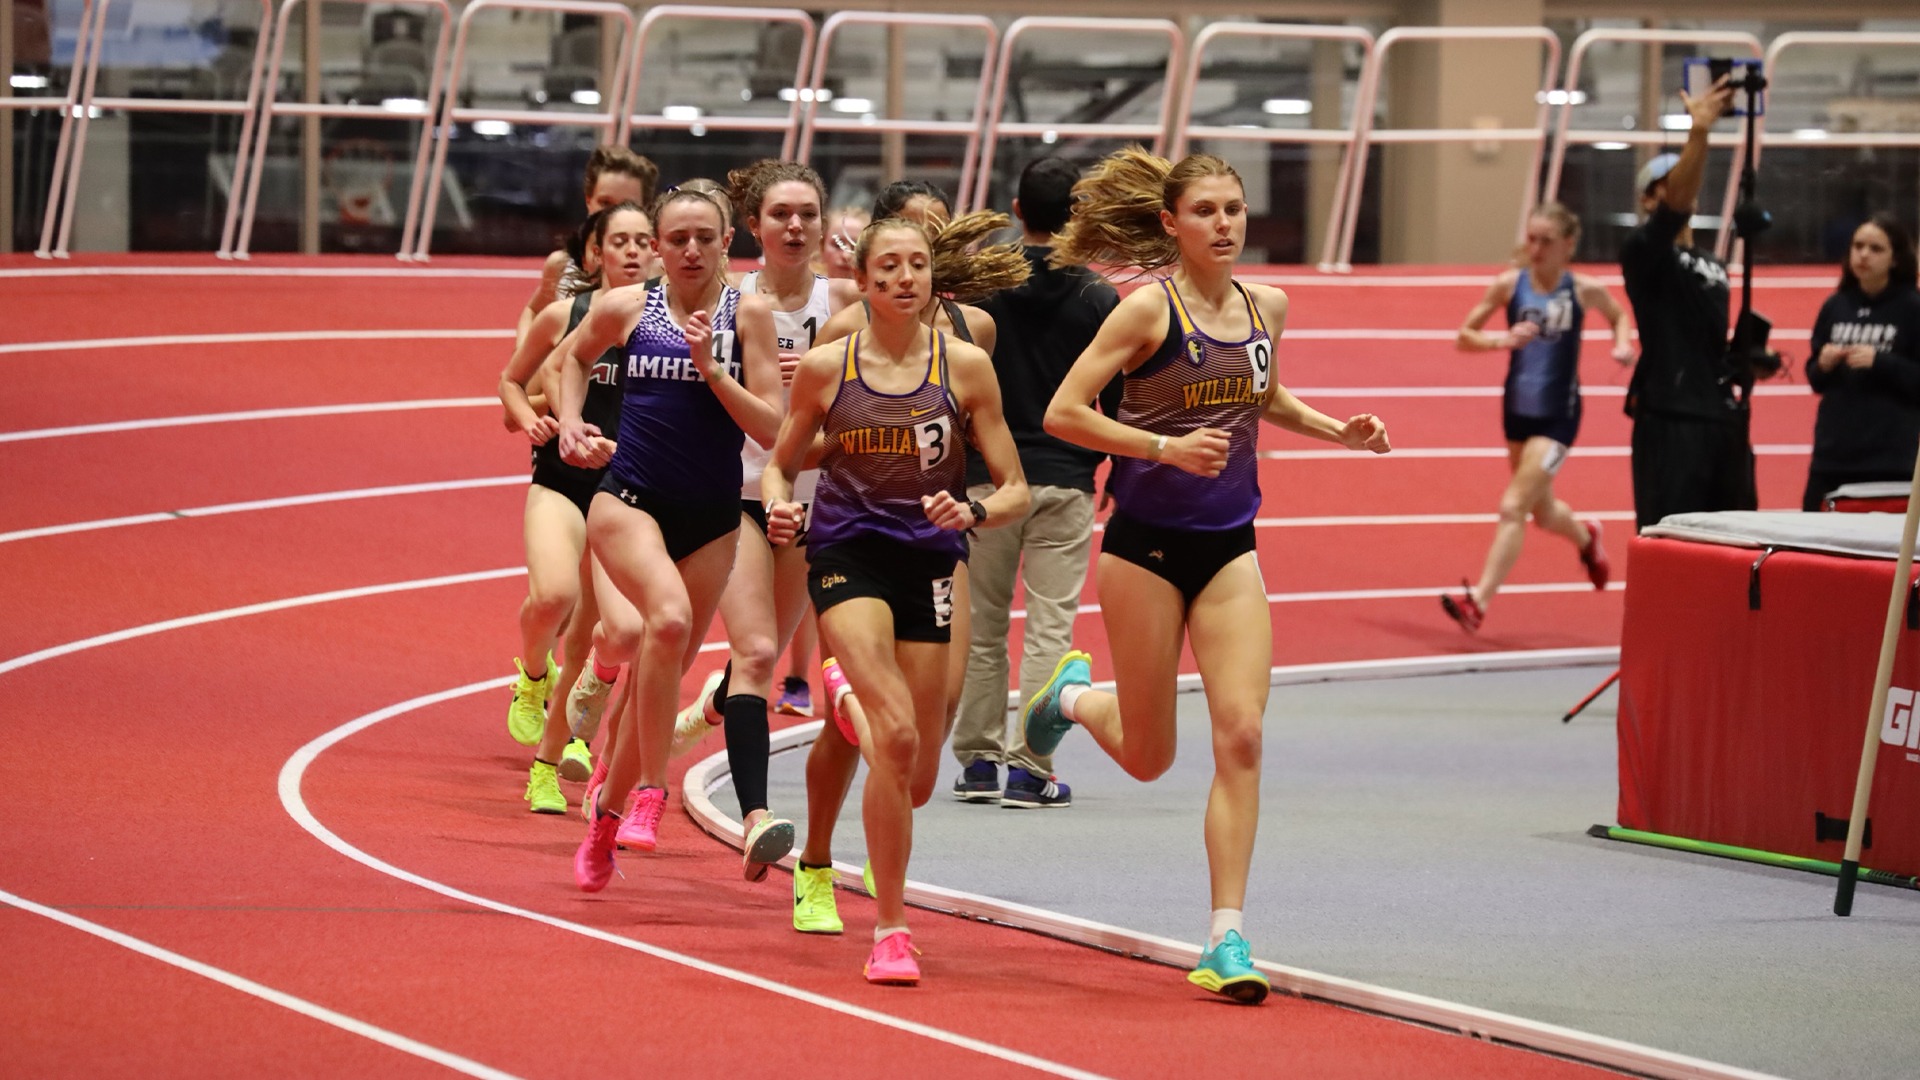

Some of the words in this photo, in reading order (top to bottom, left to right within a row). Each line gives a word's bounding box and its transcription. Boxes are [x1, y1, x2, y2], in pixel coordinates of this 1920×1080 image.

[628, 354, 742, 383] AMHET
[1254, 344, 1269, 389] 9
[1183, 377, 1267, 410] WILLIA
[839, 427, 920, 457] WILLIA
[923, 423, 945, 466] 3
[1880, 686, 1920, 751] GI
